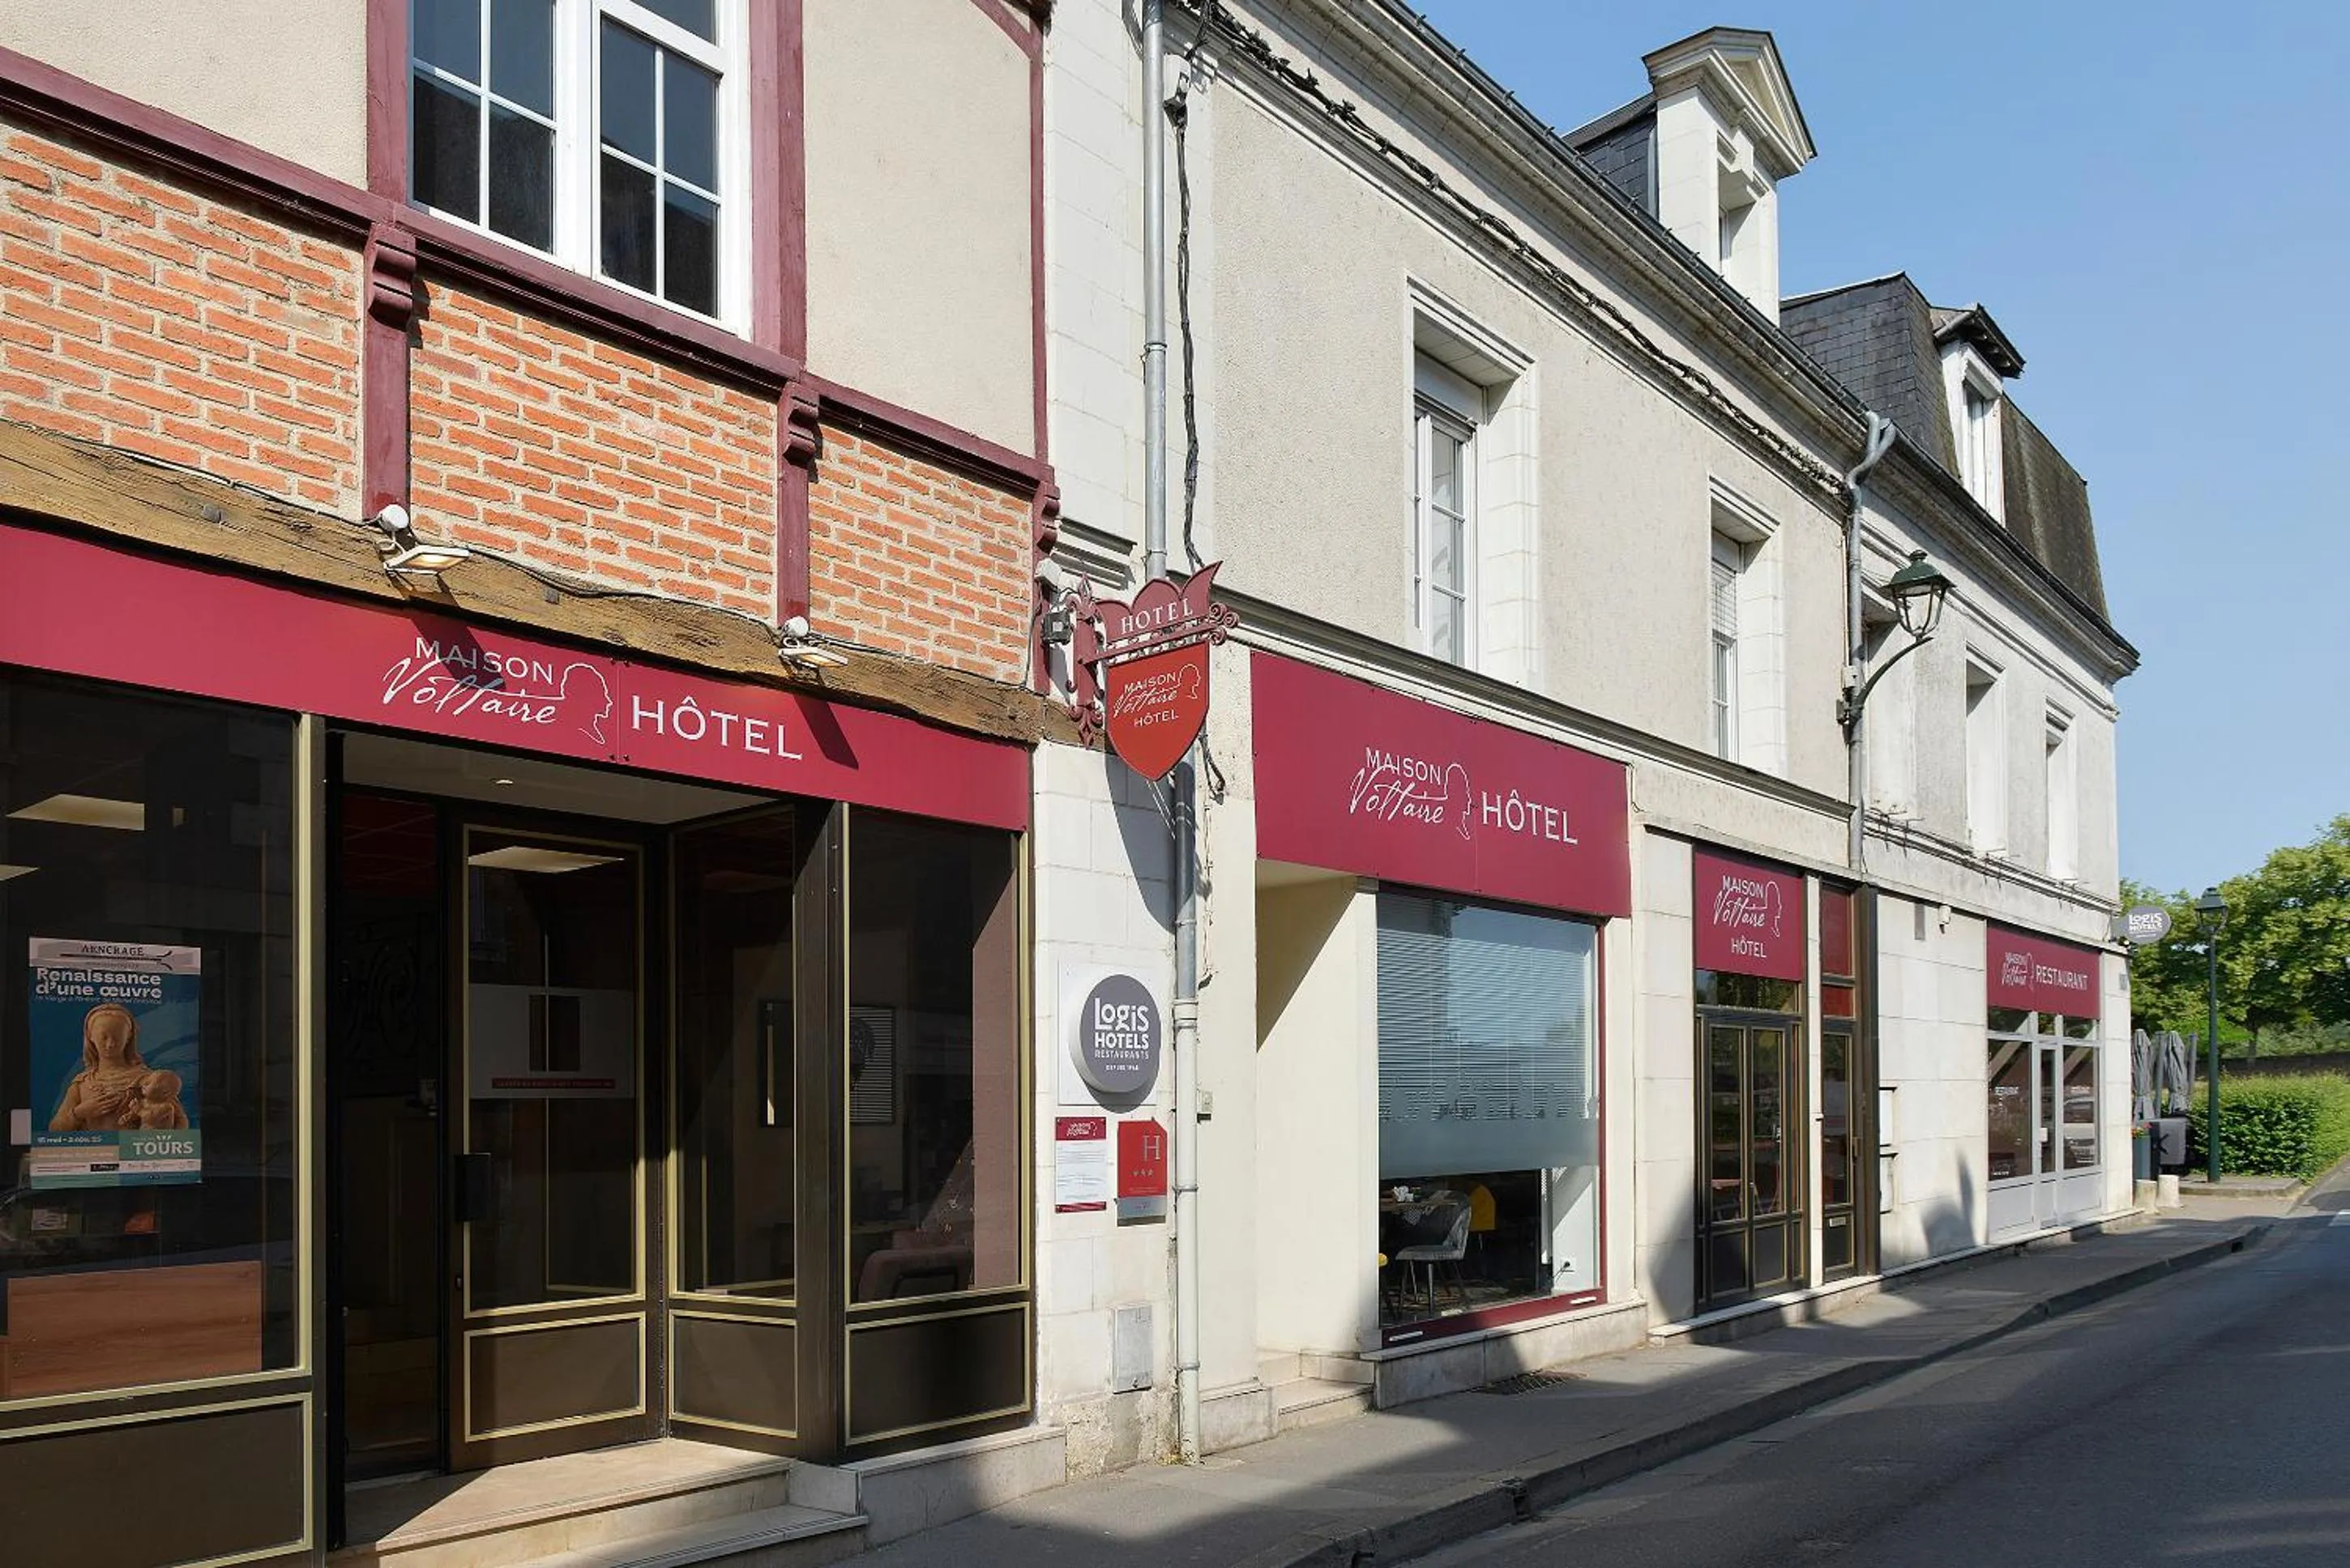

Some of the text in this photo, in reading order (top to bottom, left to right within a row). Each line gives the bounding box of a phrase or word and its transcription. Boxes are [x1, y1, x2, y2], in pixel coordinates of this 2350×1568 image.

[1121, 598, 1194, 635] HOTEL
[416, 635, 555, 685] MAISON
[382, 656, 566, 725] Voltaire
[1123, 672, 1177, 694] MAISON
[1113, 683, 1180, 719] Voltaire
[631, 694, 803, 760] HÔTEL
[1134, 709, 1180, 728] HÔTEL
[1365, 746, 1443, 785] MAISON
[1348, 764, 1448, 825] Voltaire
[1481, 788, 1579, 845] HÔTEL
[1722, 874, 1764, 898] MAISON
[1713, 886, 1767, 929] Voltaire
[1730, 934, 1767, 958] HÔTEL
[36, 967, 162, 985] Renaissance
[36, 980, 163, 998] d'une œuvre
[2036, 963, 2088, 991] RESTAURANT
[1094, 1032, 1150, 1050] HOTELS
[1094, 1049, 1150, 1060] RESTAURANTS
[132, 1141, 194, 1156] TOURS
[1142, 1134, 1161, 1163] H
